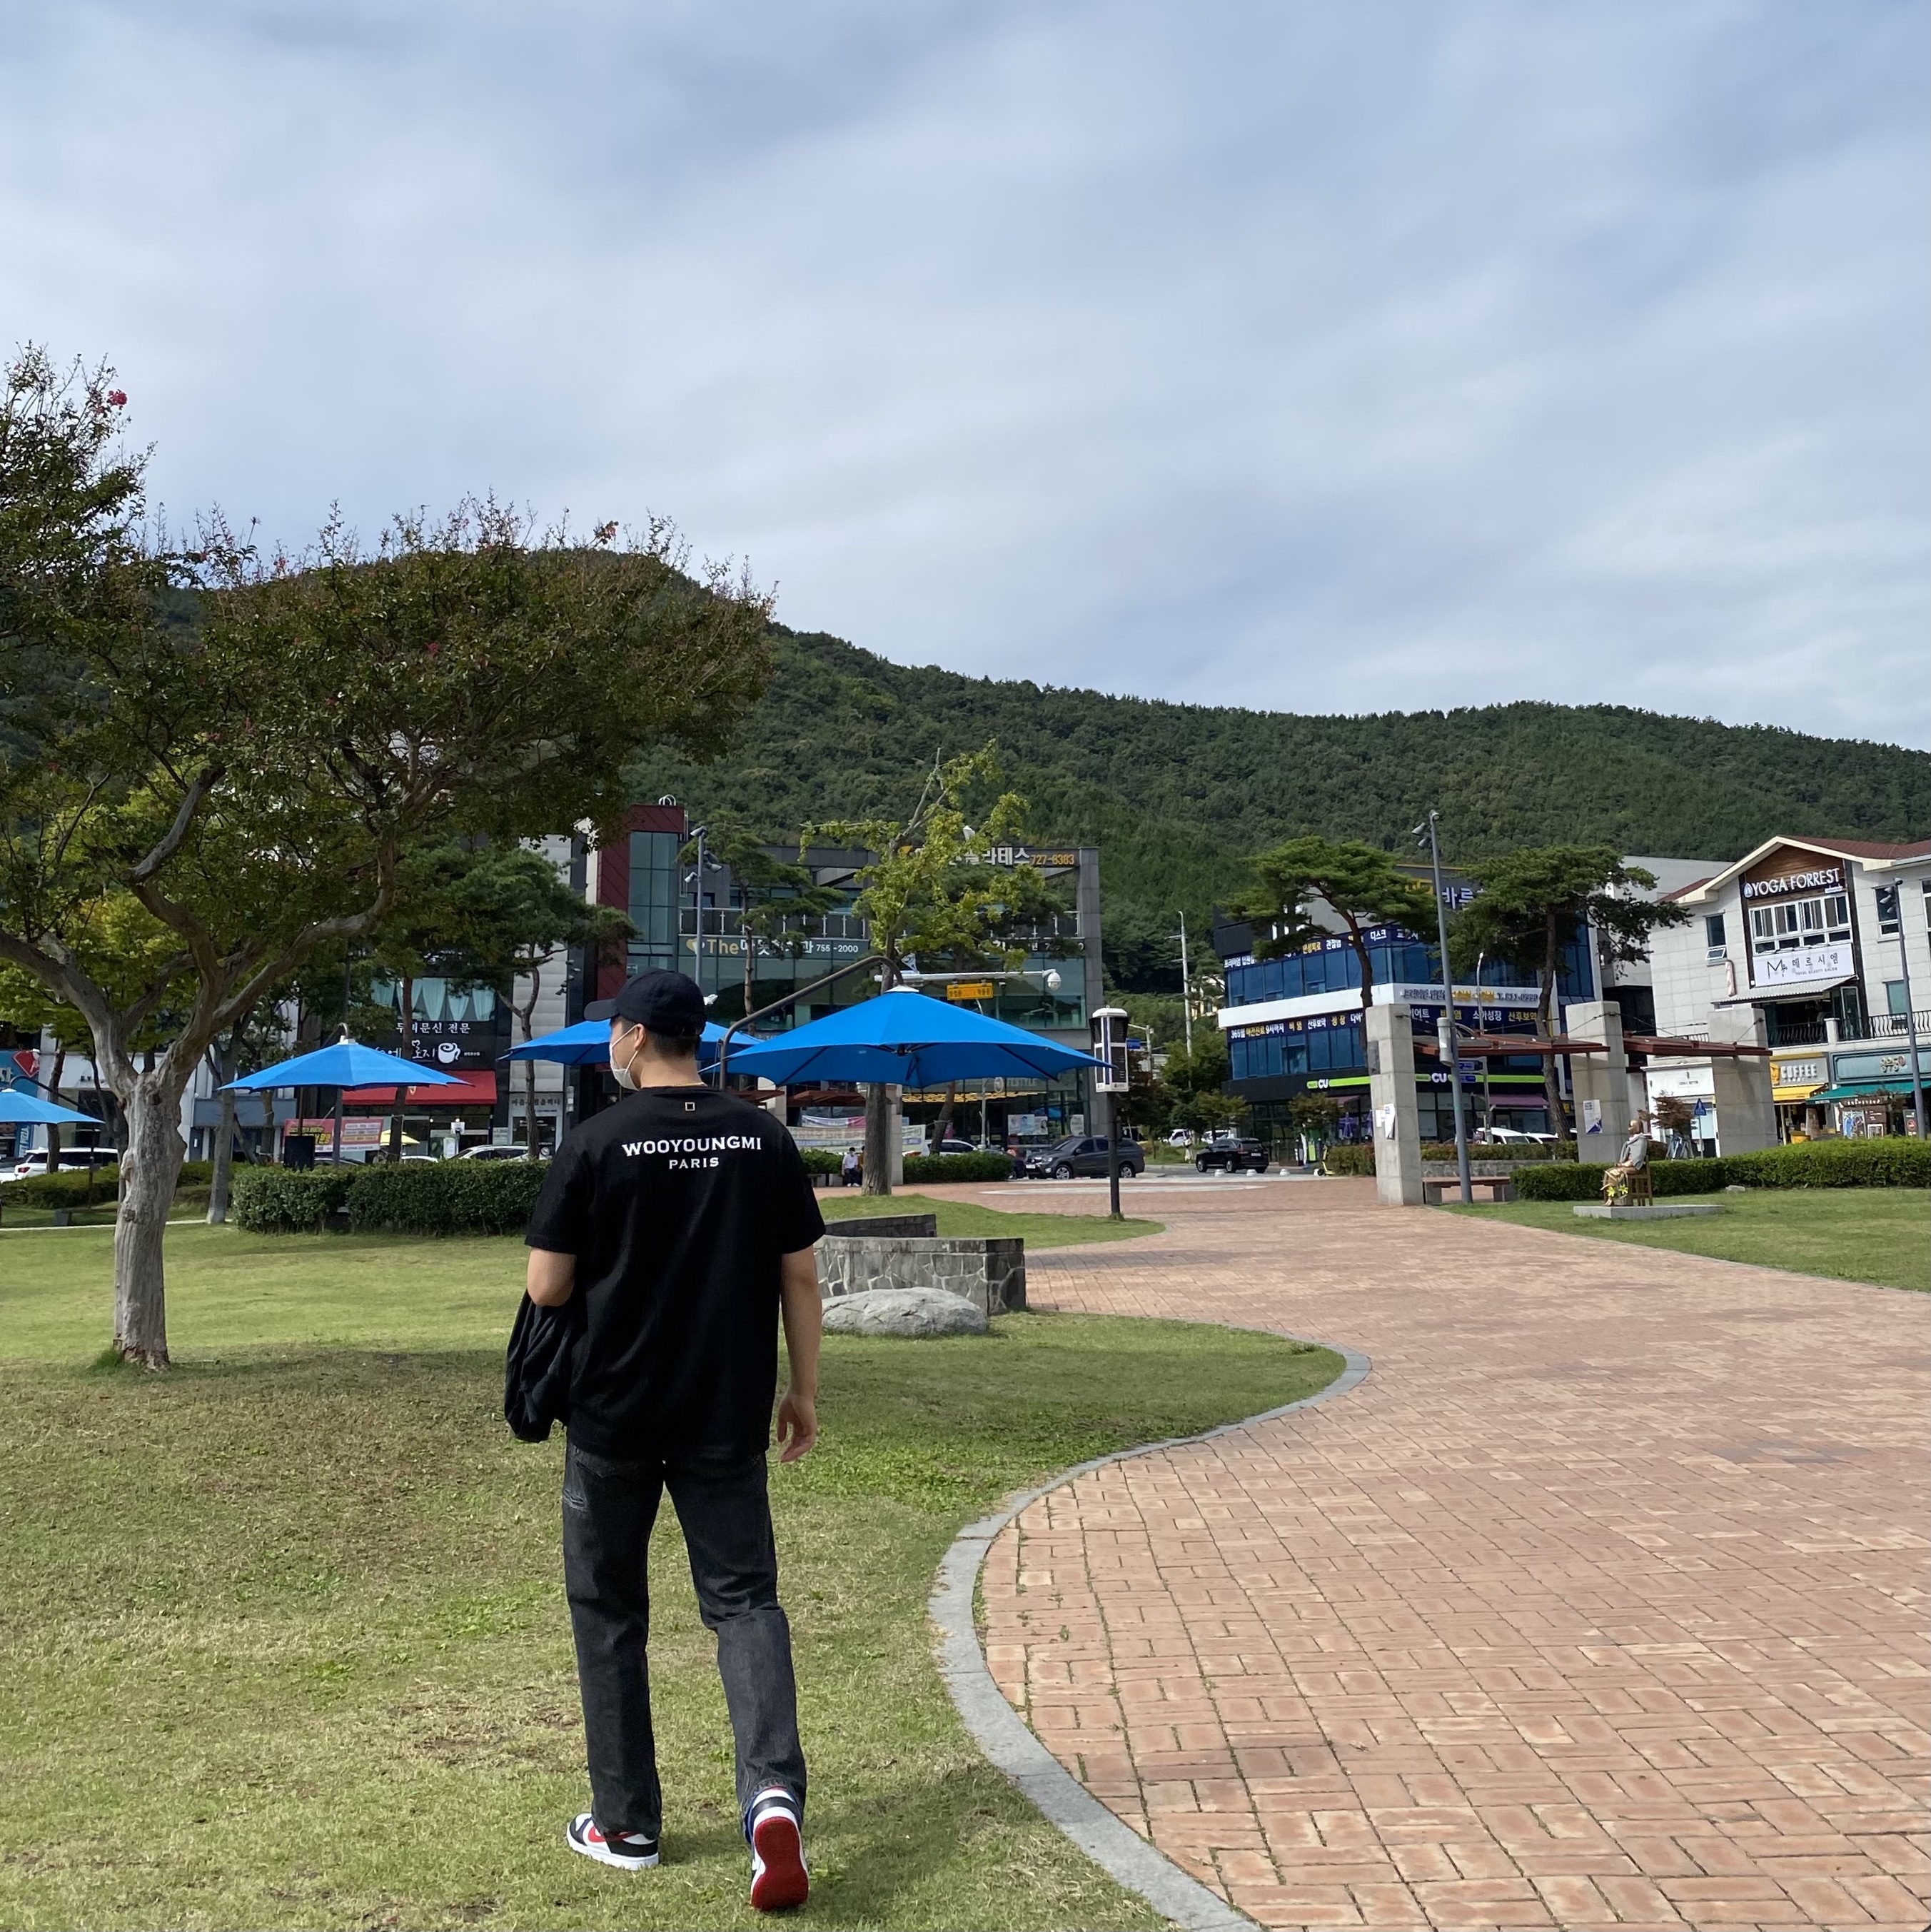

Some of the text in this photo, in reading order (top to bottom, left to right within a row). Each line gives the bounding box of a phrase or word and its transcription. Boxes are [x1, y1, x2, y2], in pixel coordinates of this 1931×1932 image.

[1753, 867, 1840, 896] YOGA FORREST
[448, 1022, 470, 1034] 전문
[1432, 1072, 1448, 1082] CU
[1318, 1079, 1328, 1088] CU
[622, 1136, 761, 1157] WOOYOUNGMI
[669, 1157, 719, 1169] PARIS
